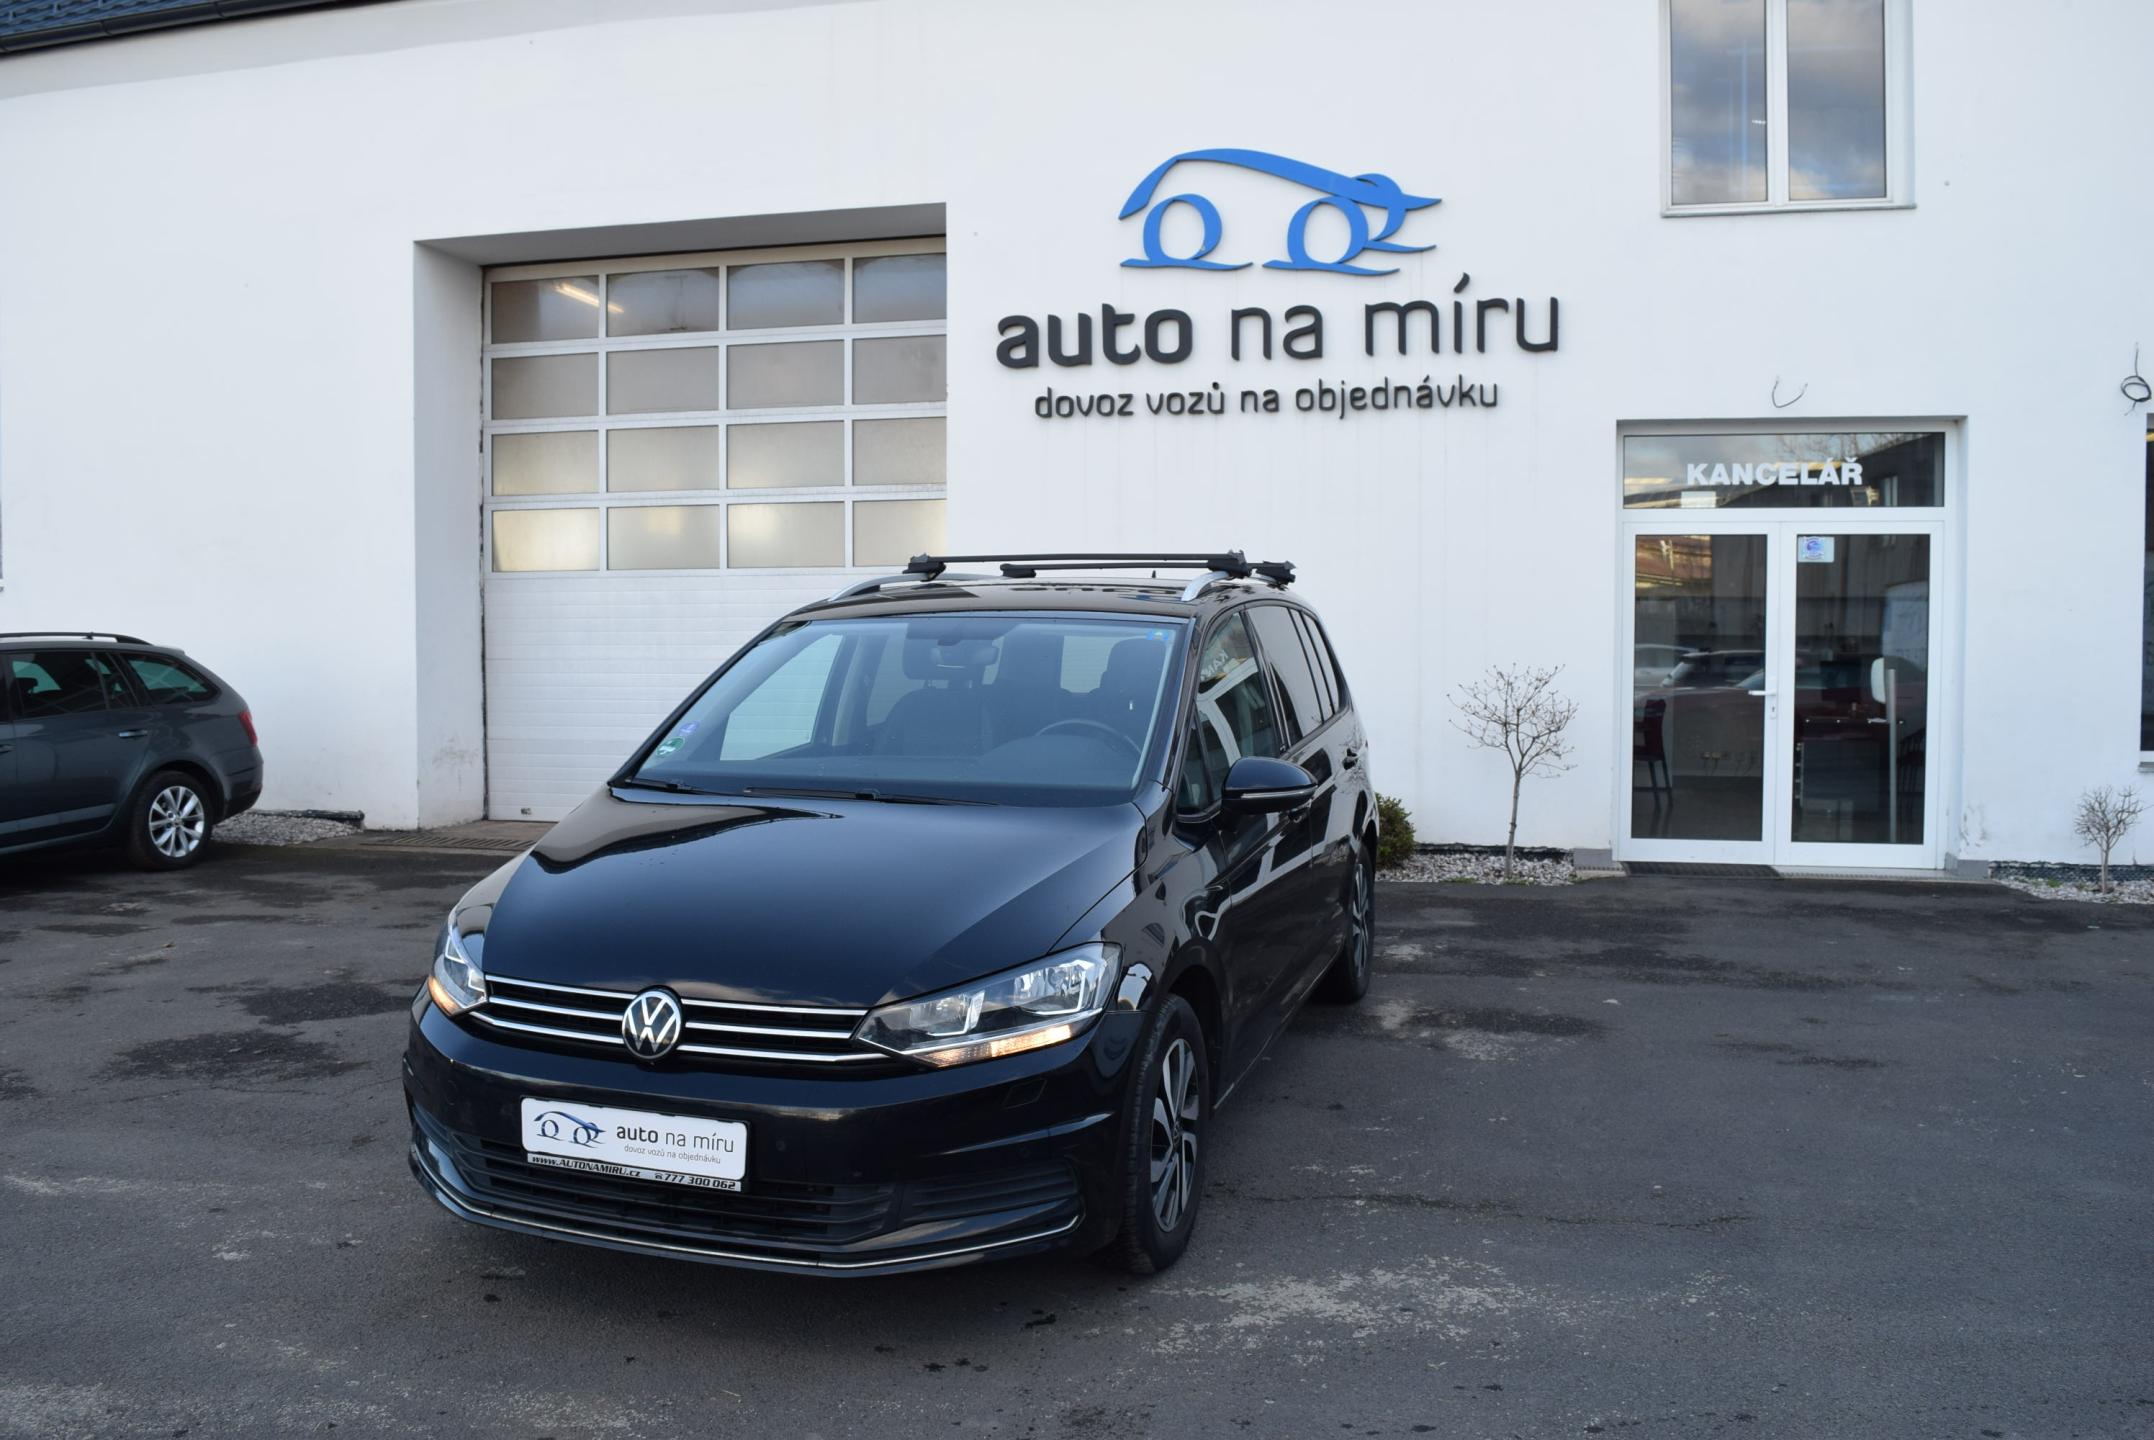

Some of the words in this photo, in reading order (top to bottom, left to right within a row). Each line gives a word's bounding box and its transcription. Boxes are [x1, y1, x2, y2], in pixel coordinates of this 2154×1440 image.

[997, 303, 1193, 368] auto
[1231, 304, 1323, 361] na
[1365, 272, 1559, 356] míru
[1034, 387, 1135, 418] dovoz
[1146, 381, 1225, 415] vozů
[1240, 386, 1280, 413] na
[1295, 374, 1498, 419] objednávku
[1687, 457, 1863, 486] KANCELÁŘ
[616, 1125, 659, 1144] auto
[665, 1132, 686, 1147] na
[693, 1132, 734, 1153] míru
[624, 1144, 646, 1155] dovoz
[647, 1148, 665, 1157] vozů
[678, 1152, 721, 1164] objednávku
[664, 1173, 685, 1183] 777
[688, 1176, 710, 1187] 300
[712, 1180, 736, 1190] 062
